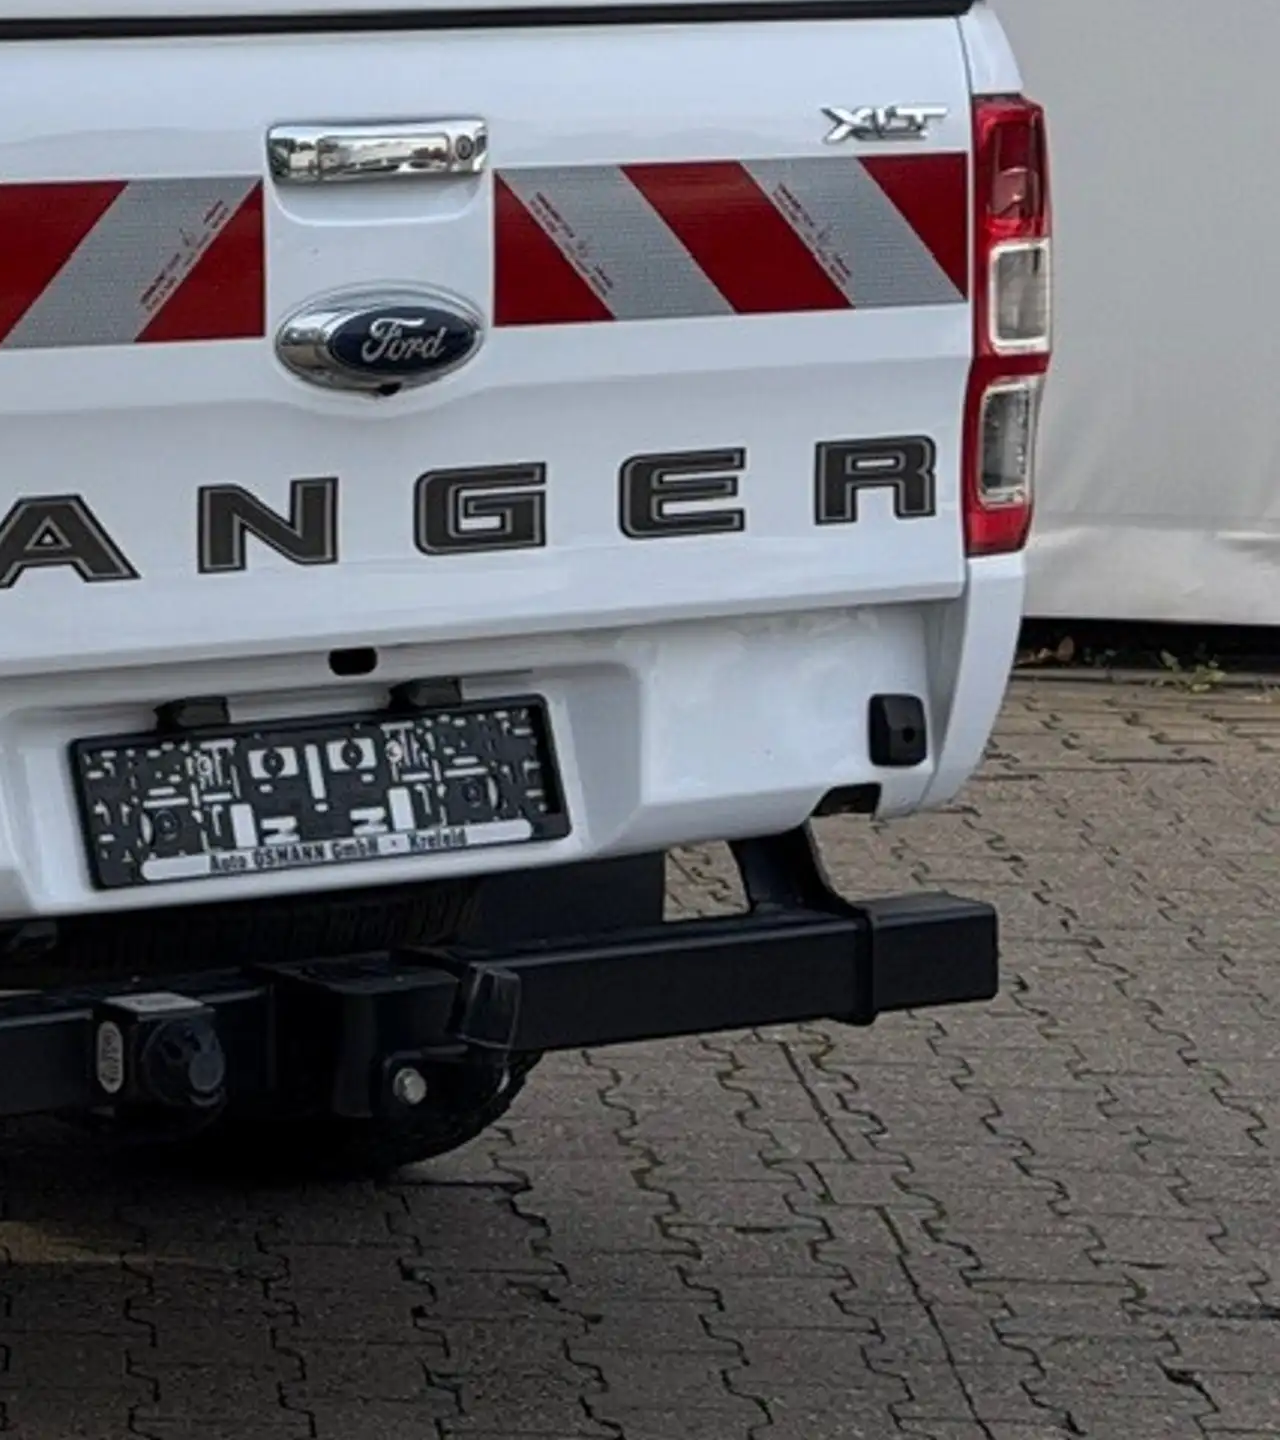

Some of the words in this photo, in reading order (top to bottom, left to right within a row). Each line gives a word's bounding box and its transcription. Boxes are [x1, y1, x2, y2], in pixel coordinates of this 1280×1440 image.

[820, 106, 948, 143] XLT
[361, 317, 447, 363] Ford
[209, 852, 247, 874] Auto
[252, 841, 326, 868] OSMANN
[331, 836, 378, 858] GmbH
[409, 828, 467, 850] Krefeld
